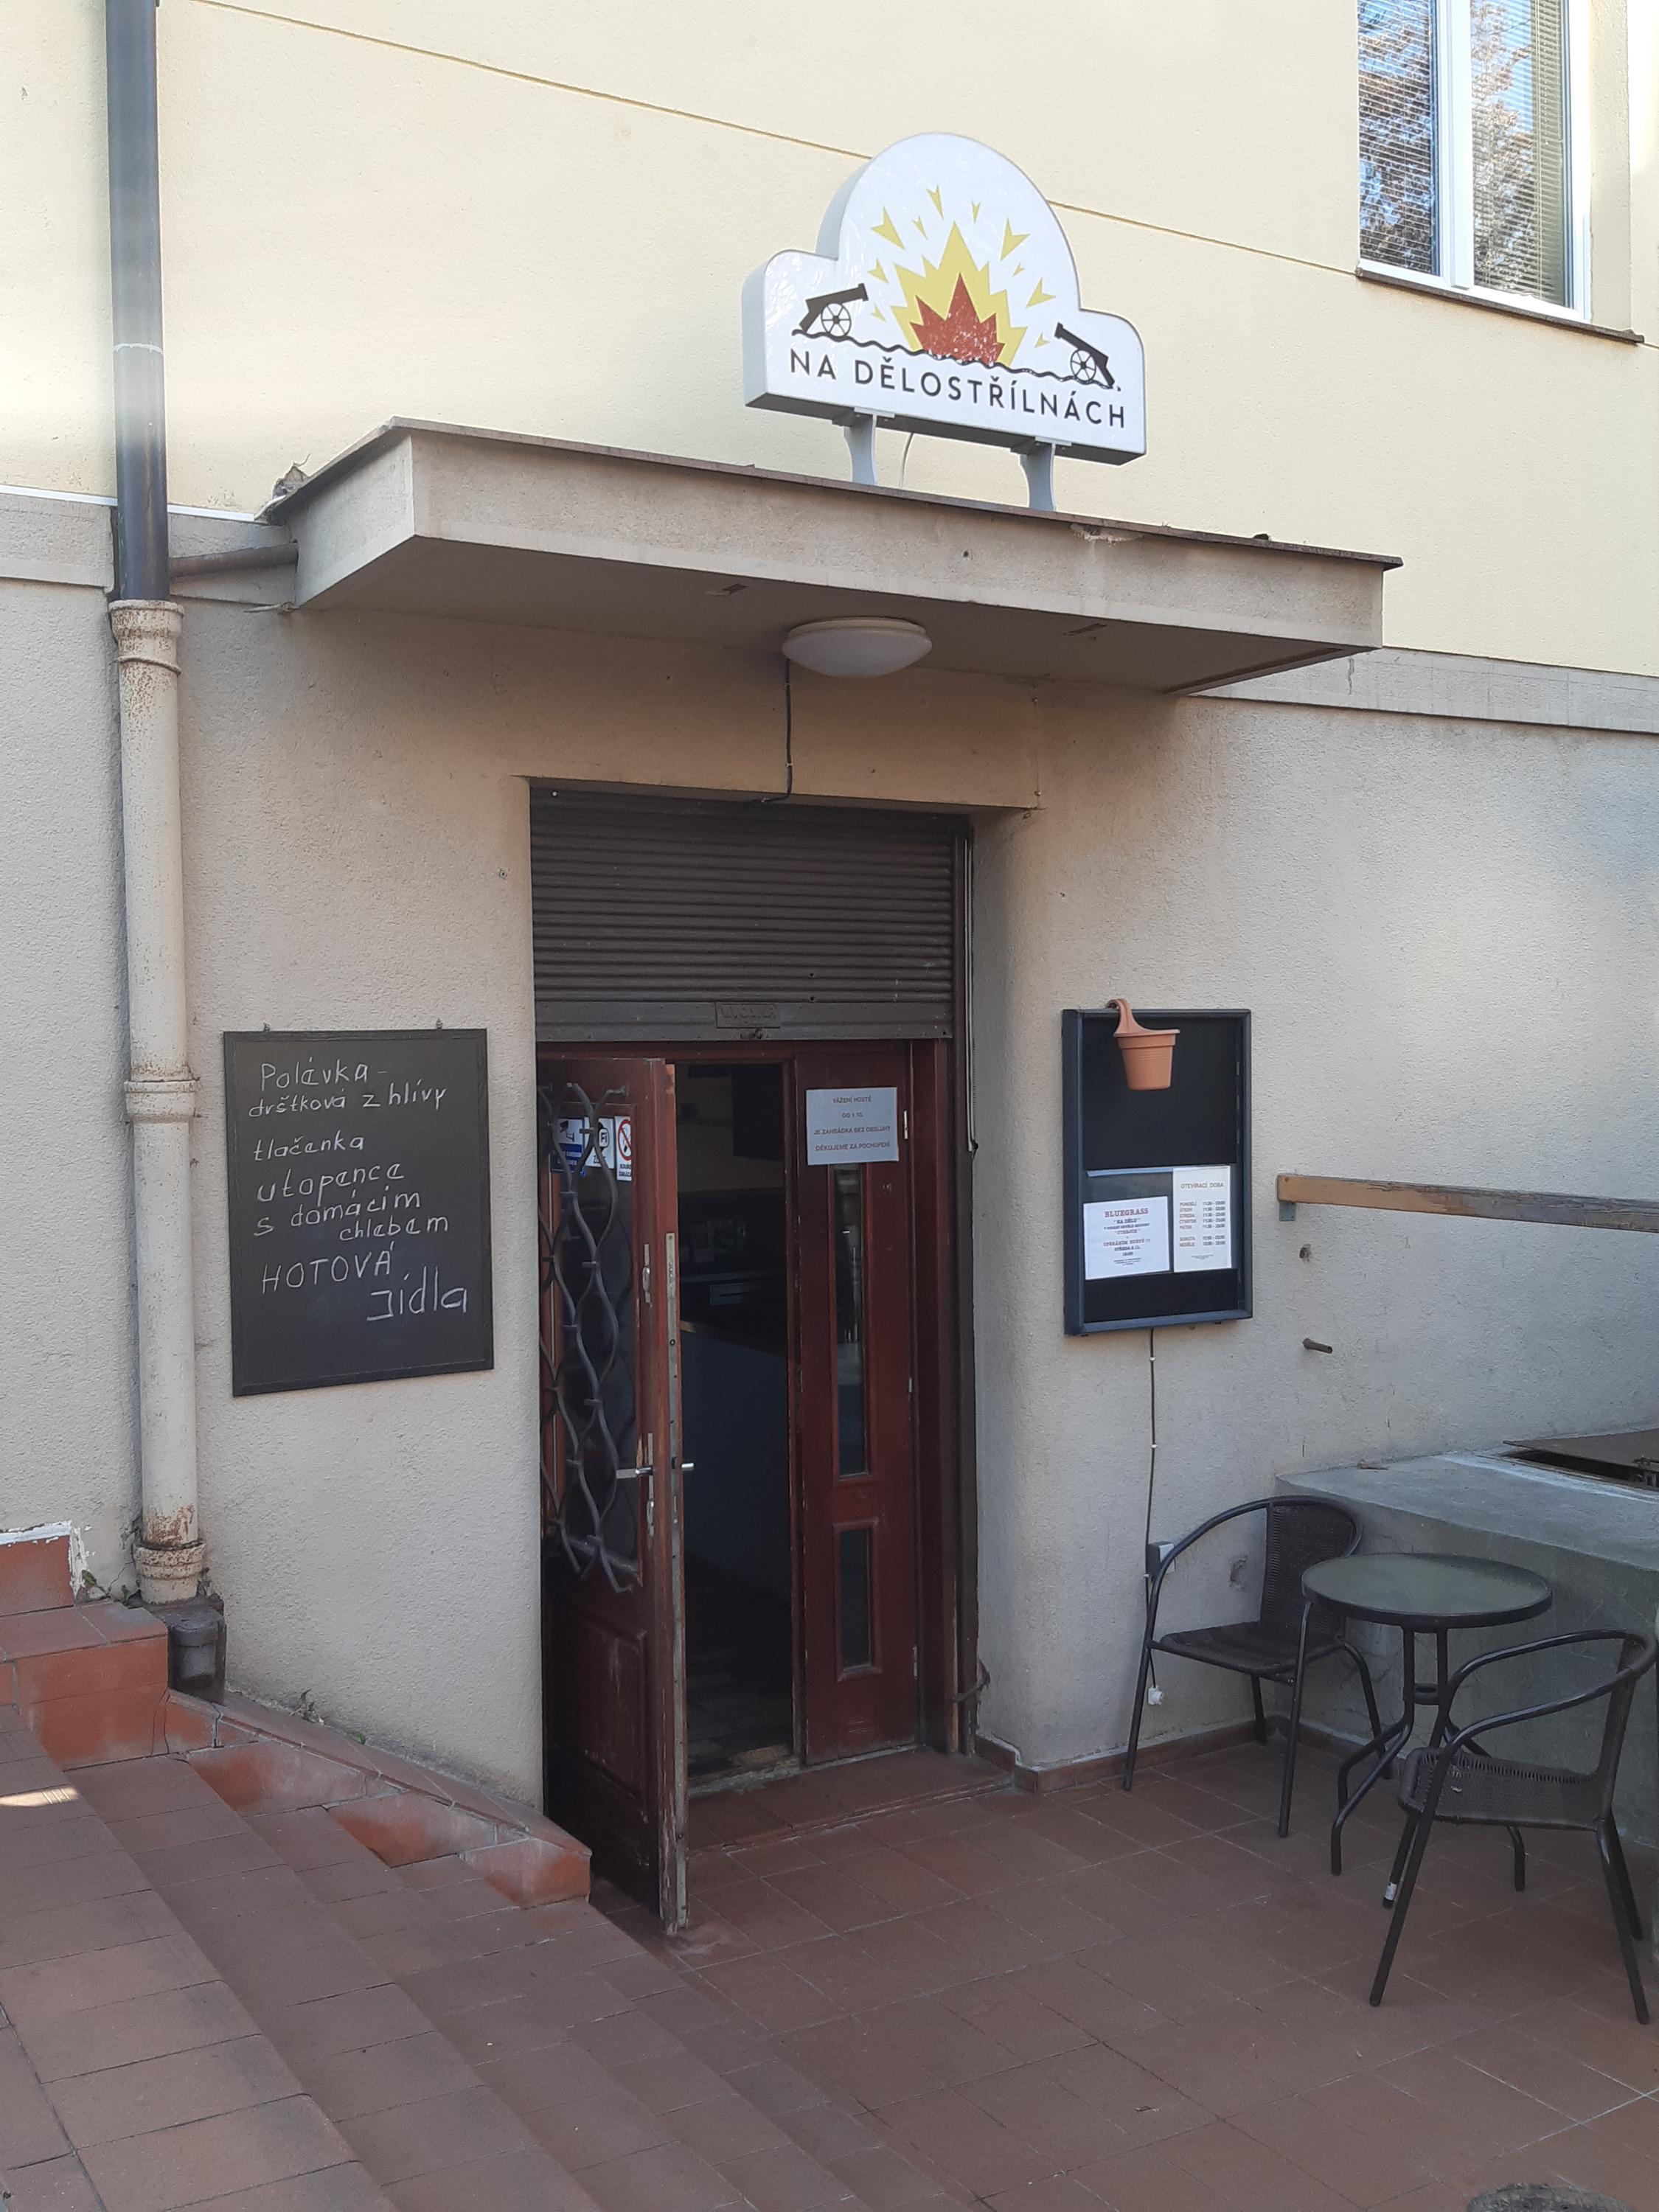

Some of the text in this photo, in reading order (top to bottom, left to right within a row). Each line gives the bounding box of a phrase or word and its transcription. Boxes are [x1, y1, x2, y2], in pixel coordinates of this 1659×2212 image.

[790, 349, 1126, 428] NA DĚLOSTŘÍLNÁCH
[261, 1057, 369, 1092] Polávka
[248, 1078, 448, 1118] drštková z hlívy
[254, 1130, 365, 1161] tlačenka
[1105, 1208, 1149, 1217] BLUEGRASS
[262, 1240, 394, 1294] HOTOVÁ
[366, 1265, 468, 1321] Jídla
